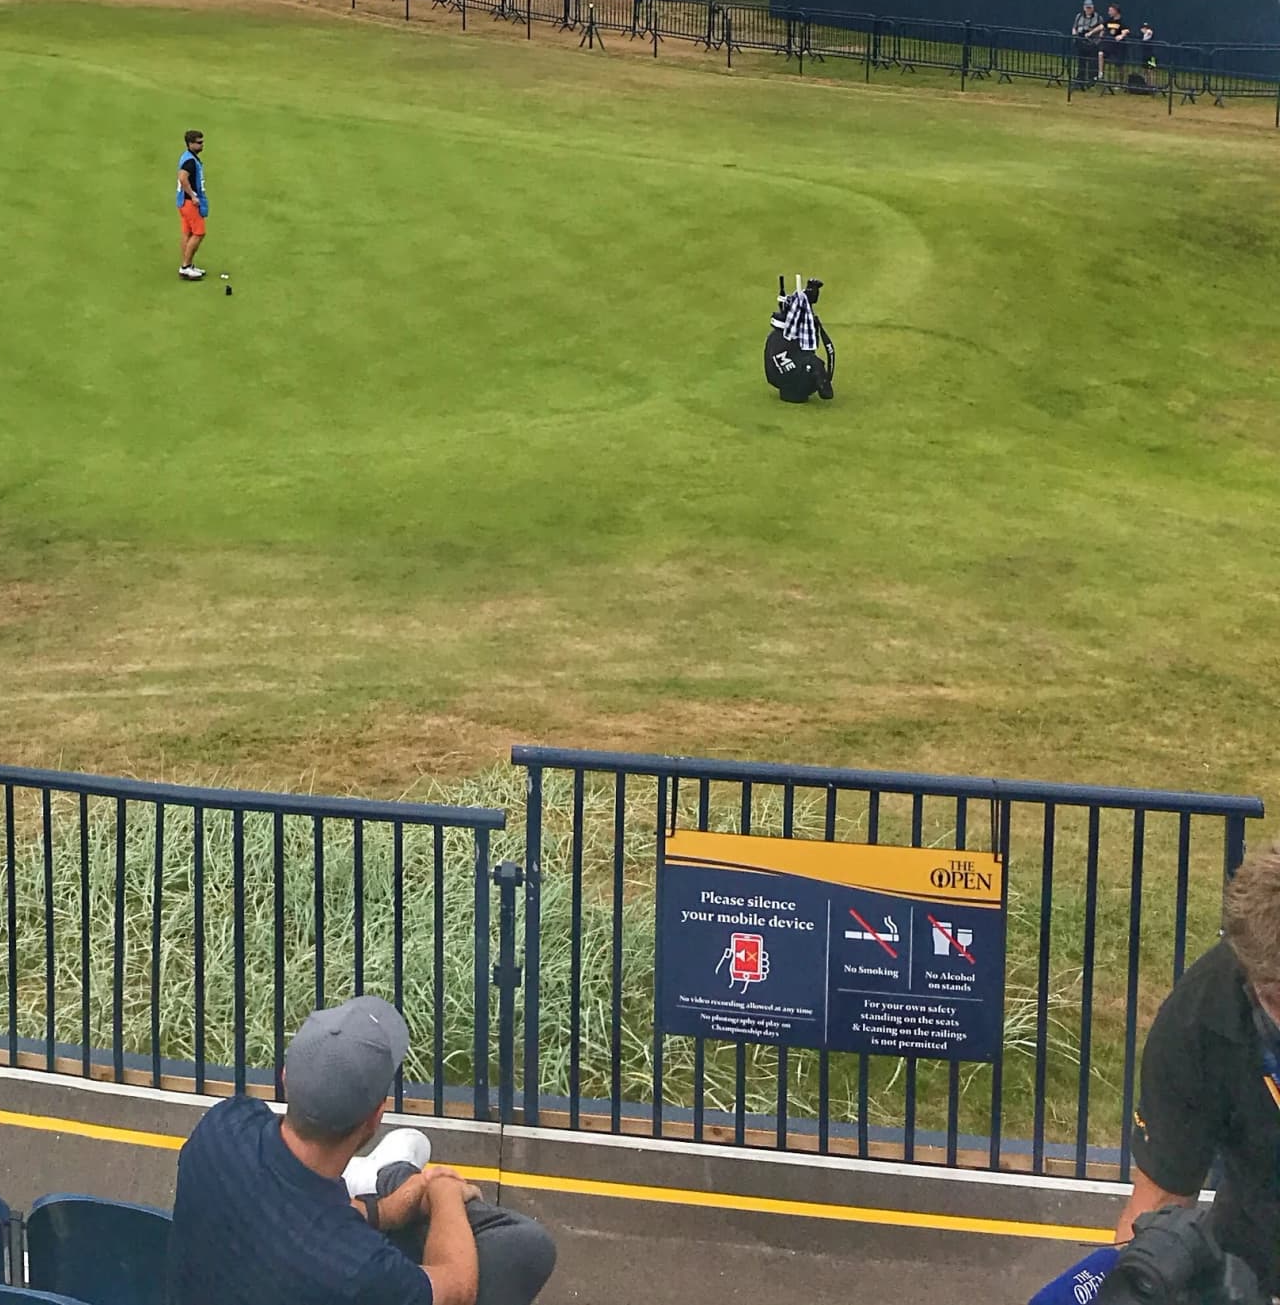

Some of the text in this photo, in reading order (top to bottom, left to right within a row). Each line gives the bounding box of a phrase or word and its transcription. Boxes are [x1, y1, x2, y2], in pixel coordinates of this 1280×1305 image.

[948, 860, 975, 872] THE
[930, 868, 992, 891] OPEN
[701, 891, 796, 910] Please silence
[681, 910, 815, 930] your mobile device
[844, 965, 899, 979] No Smoking
[925, 971, 975, 982] No Alcohol
[928, 982, 972, 992] on stands
[691, 997, 709, 1005] video
[746, 1002, 773, 1011] allowed
[783, 1006, 794, 1014] any
[864, 999, 956, 1016] For your own safety
[712, 1014, 756, 1025] photography
[766, 1020, 780, 1028] play
[860, 1012, 902, 1024] standing
[918, 1016, 934, 1025] the
[936, 1018, 960, 1026] seats
[711, 1024, 779, 1037] Championship days
[852, 1023, 861, 1031] &
[862, 1024, 898, 1036] leaning
[913, 1027, 930, 1037] the
[931, 1028, 967, 1041] railings
[871, 1036, 948, 1050] is not permitted
[1073, 1270, 1093, 1284] THE
